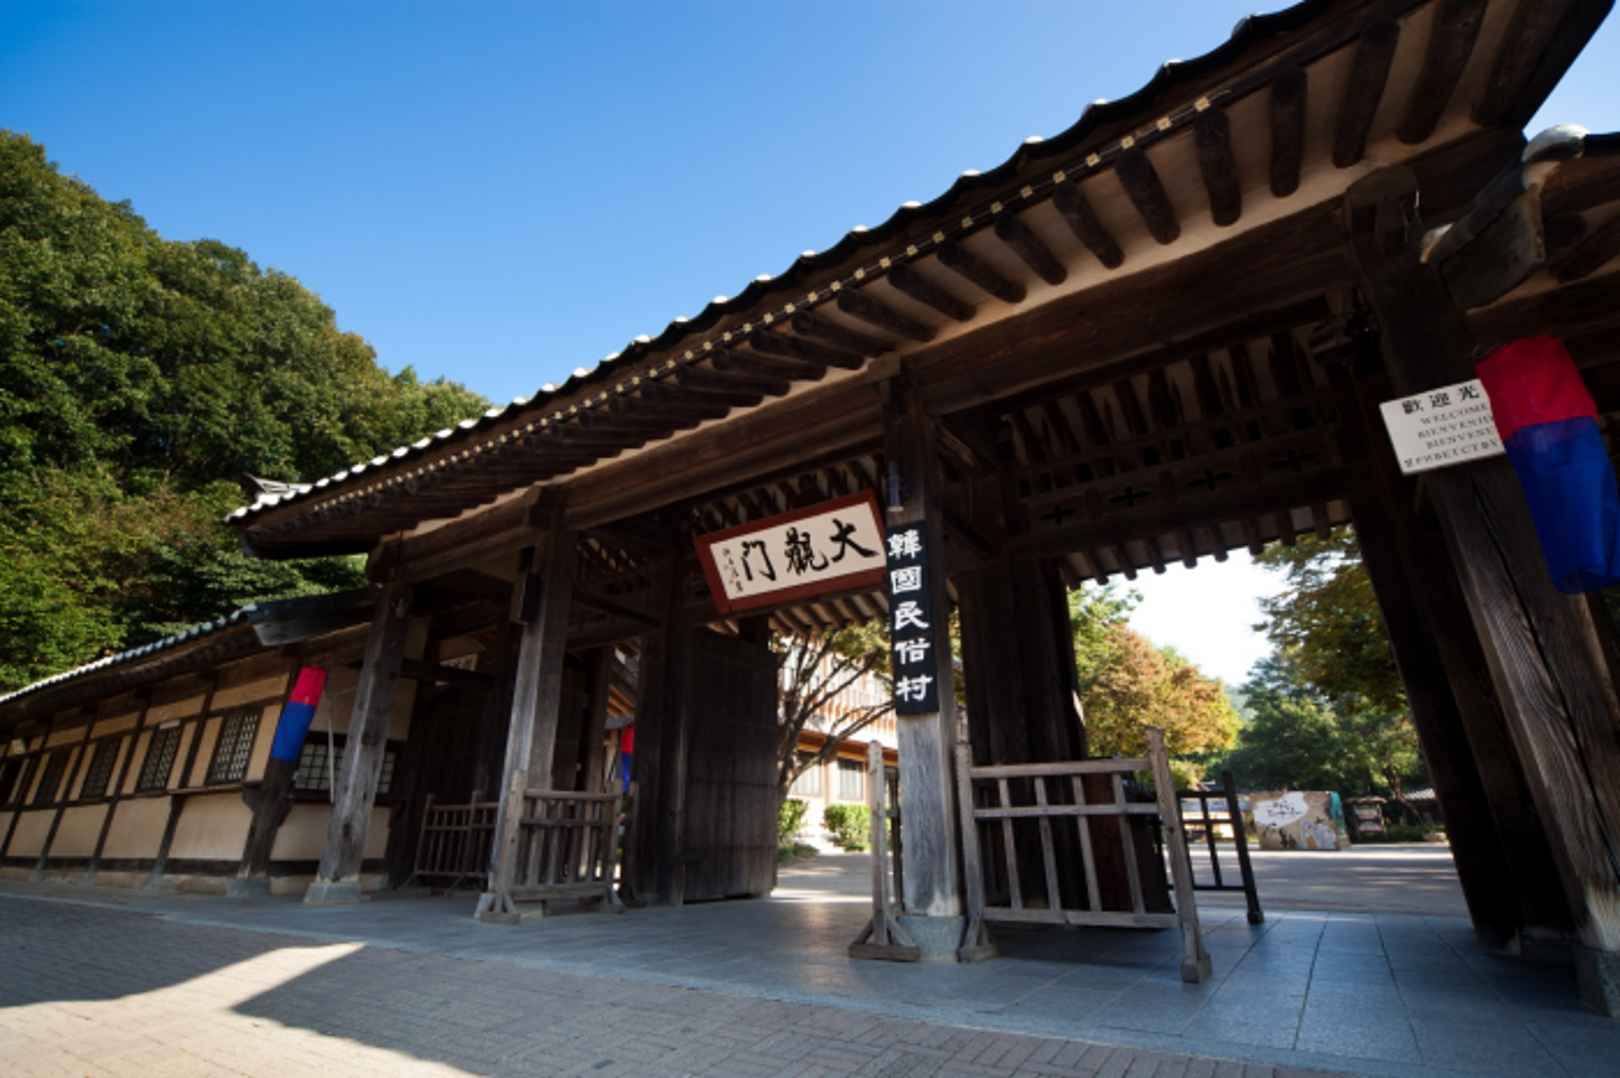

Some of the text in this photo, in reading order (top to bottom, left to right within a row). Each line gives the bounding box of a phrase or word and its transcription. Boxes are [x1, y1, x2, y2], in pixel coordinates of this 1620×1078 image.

[1402, 384, 1480, 414] 歡迎光
[1418, 414, 1493, 439] BIENVENID
[1420, 402, 1488, 425] WELCOME
[888, 528, 933, 702] 韓國民俗村
